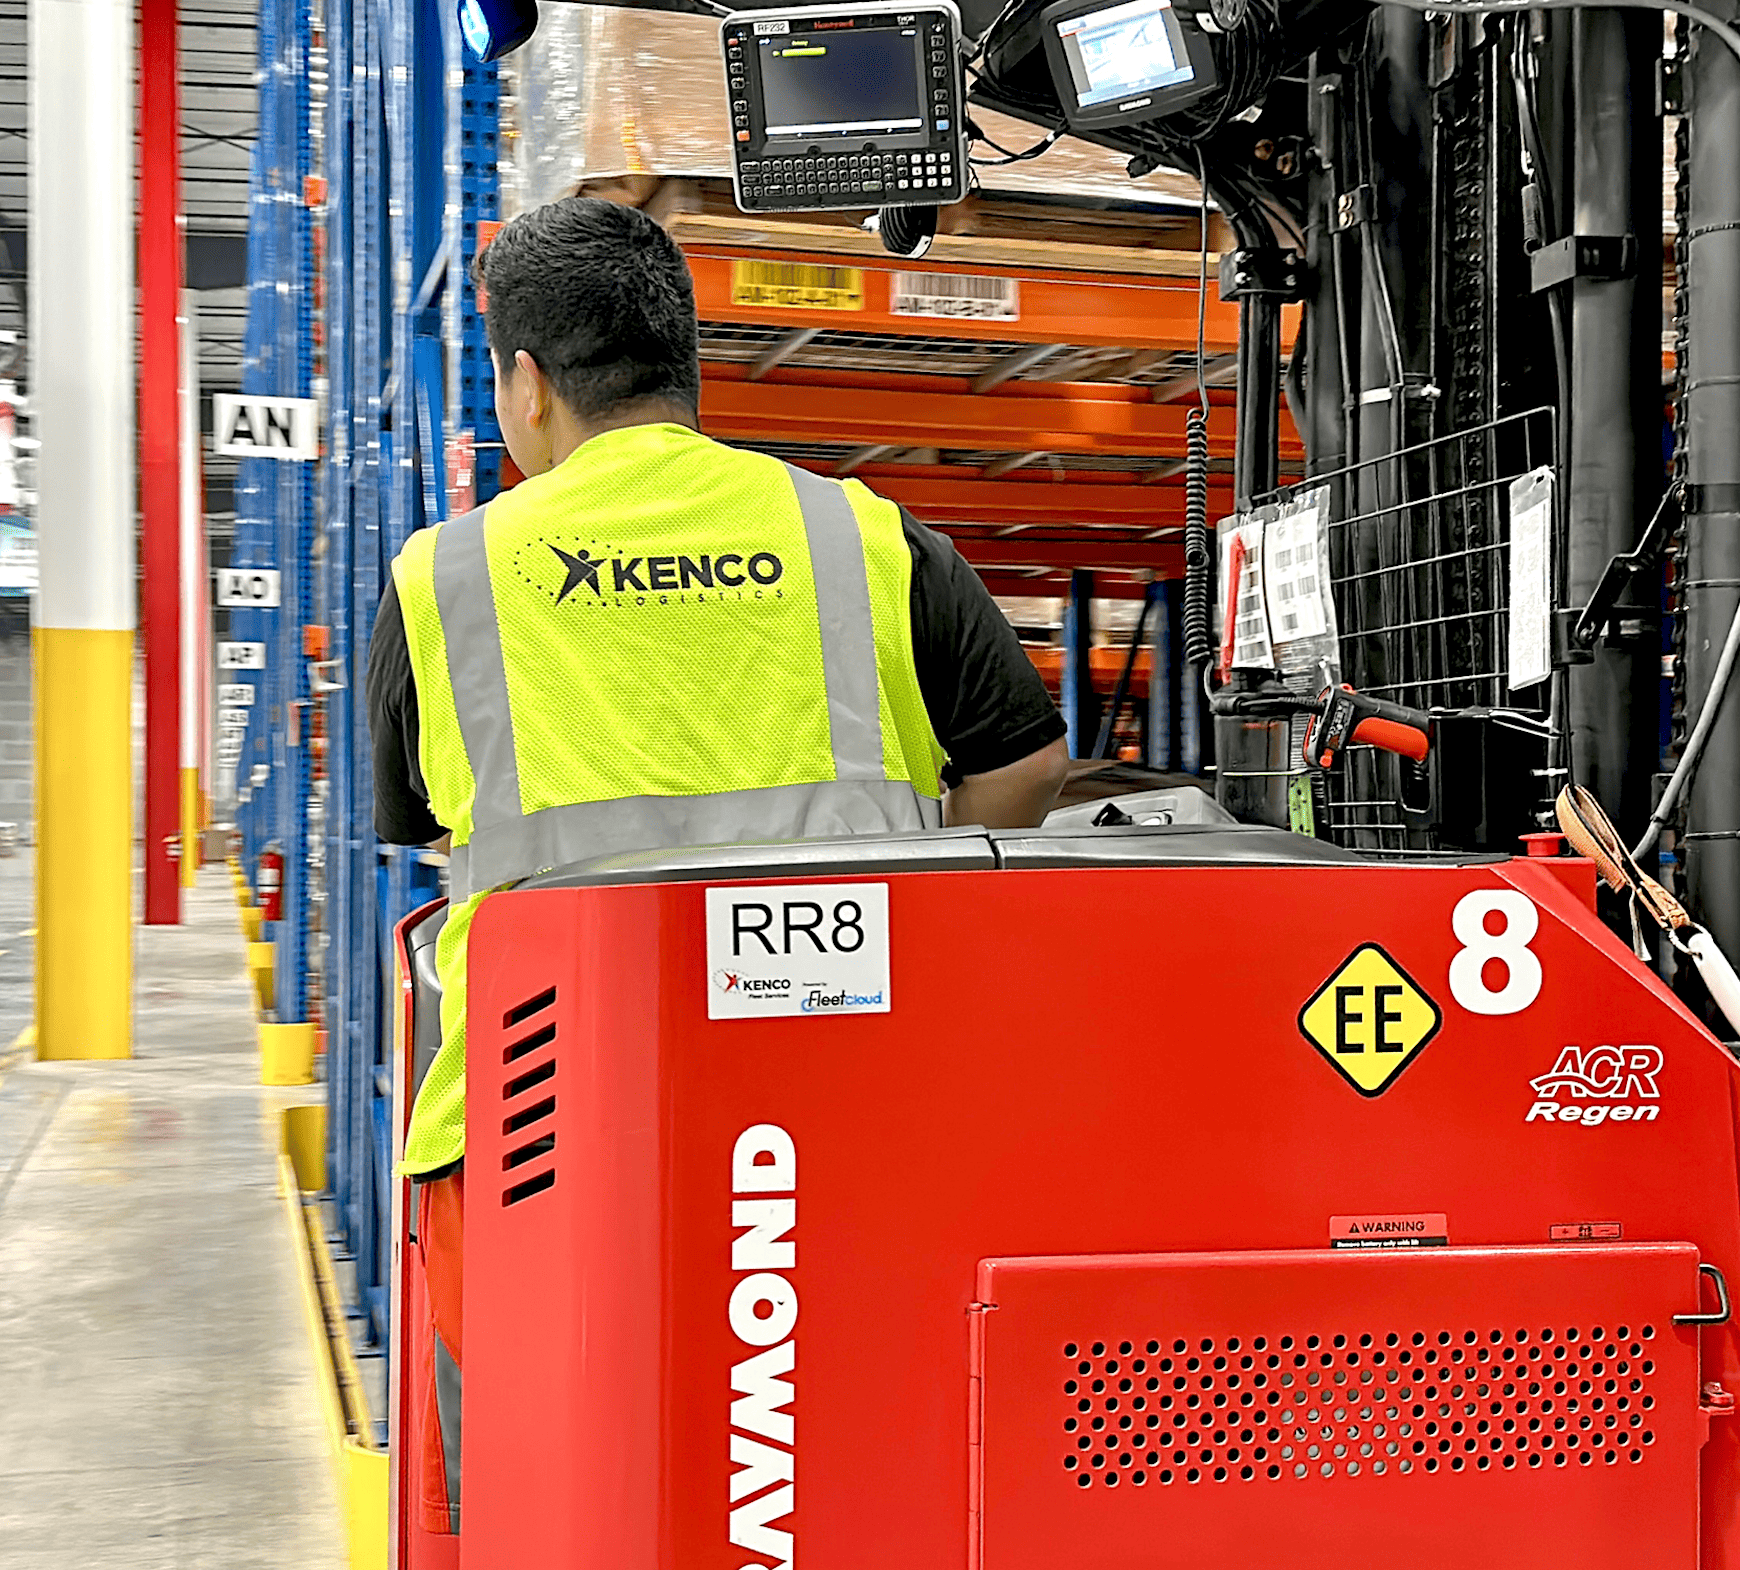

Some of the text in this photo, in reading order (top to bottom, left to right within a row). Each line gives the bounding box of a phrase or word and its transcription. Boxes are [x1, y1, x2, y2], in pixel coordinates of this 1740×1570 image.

[757, 23, 786, 33] RF232
[228, 405, 298, 449] AN
[224, 576, 268, 599] AO
[611, 552, 783, 591] KENCO
[614, 589, 783, 607] LOGISTICS
[732, 900, 865, 956] RR8
[1449, 889, 1543, 1015] 8
[743, 979, 791, 991] KENCO
[1335, 985, 1404, 1053] EE
[1529, 1045, 1664, 1098] ACR
[1525, 1101, 1660, 1126] Regen
[1362, 1221, 1425, 1232] WARNING
[1361, 1240, 1383, 1248] battery
[729, 1124, 798, 1570] AYMOND
